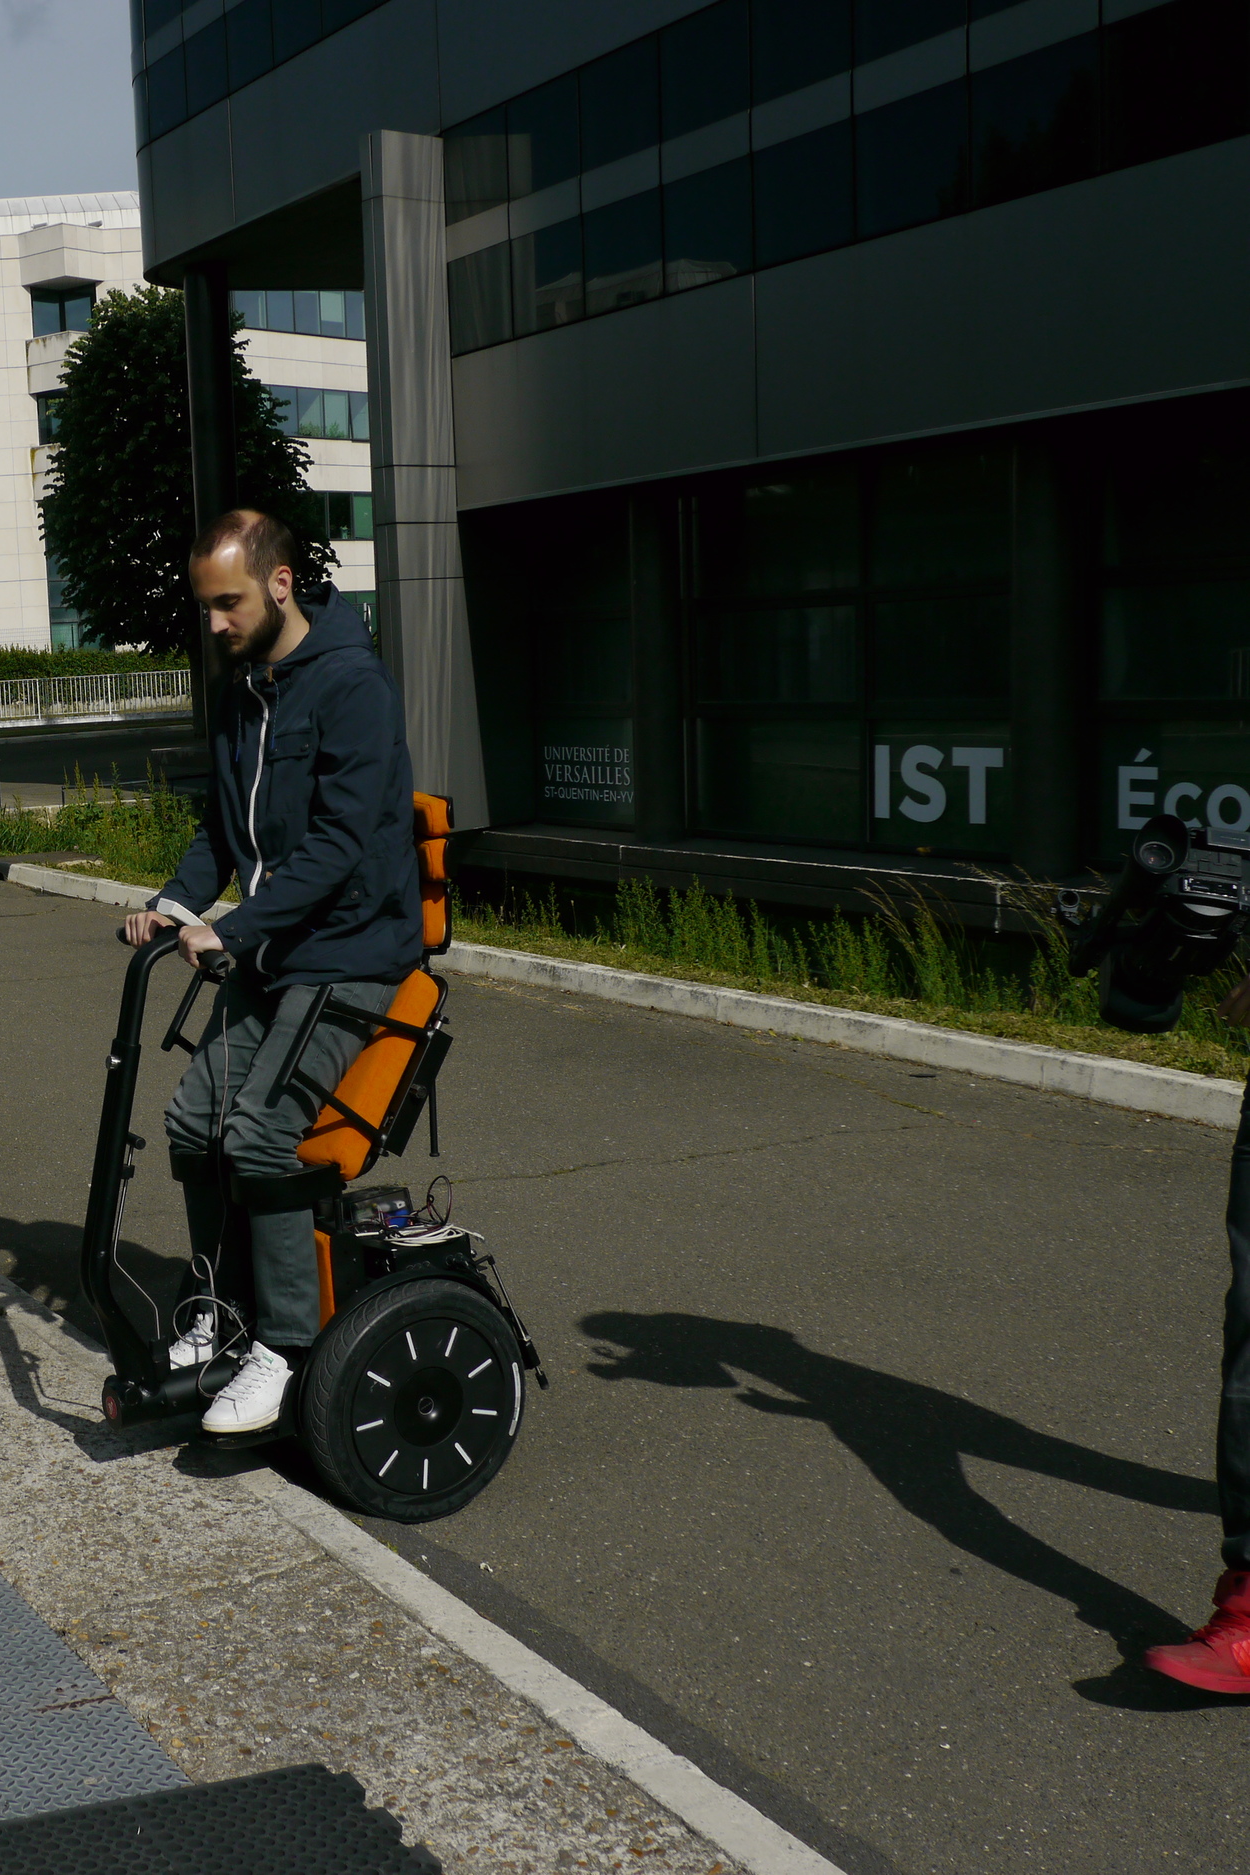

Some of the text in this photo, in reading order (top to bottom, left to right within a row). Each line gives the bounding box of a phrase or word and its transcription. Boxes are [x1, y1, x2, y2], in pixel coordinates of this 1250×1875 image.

[544, 744, 630, 763] UNIVERSITÉ DE
[544, 764, 631, 786] VERSAILLES
[874, 744, 1004, 824] IST
[544, 786, 634, 803] ST-QUENTIN-EN-YV
